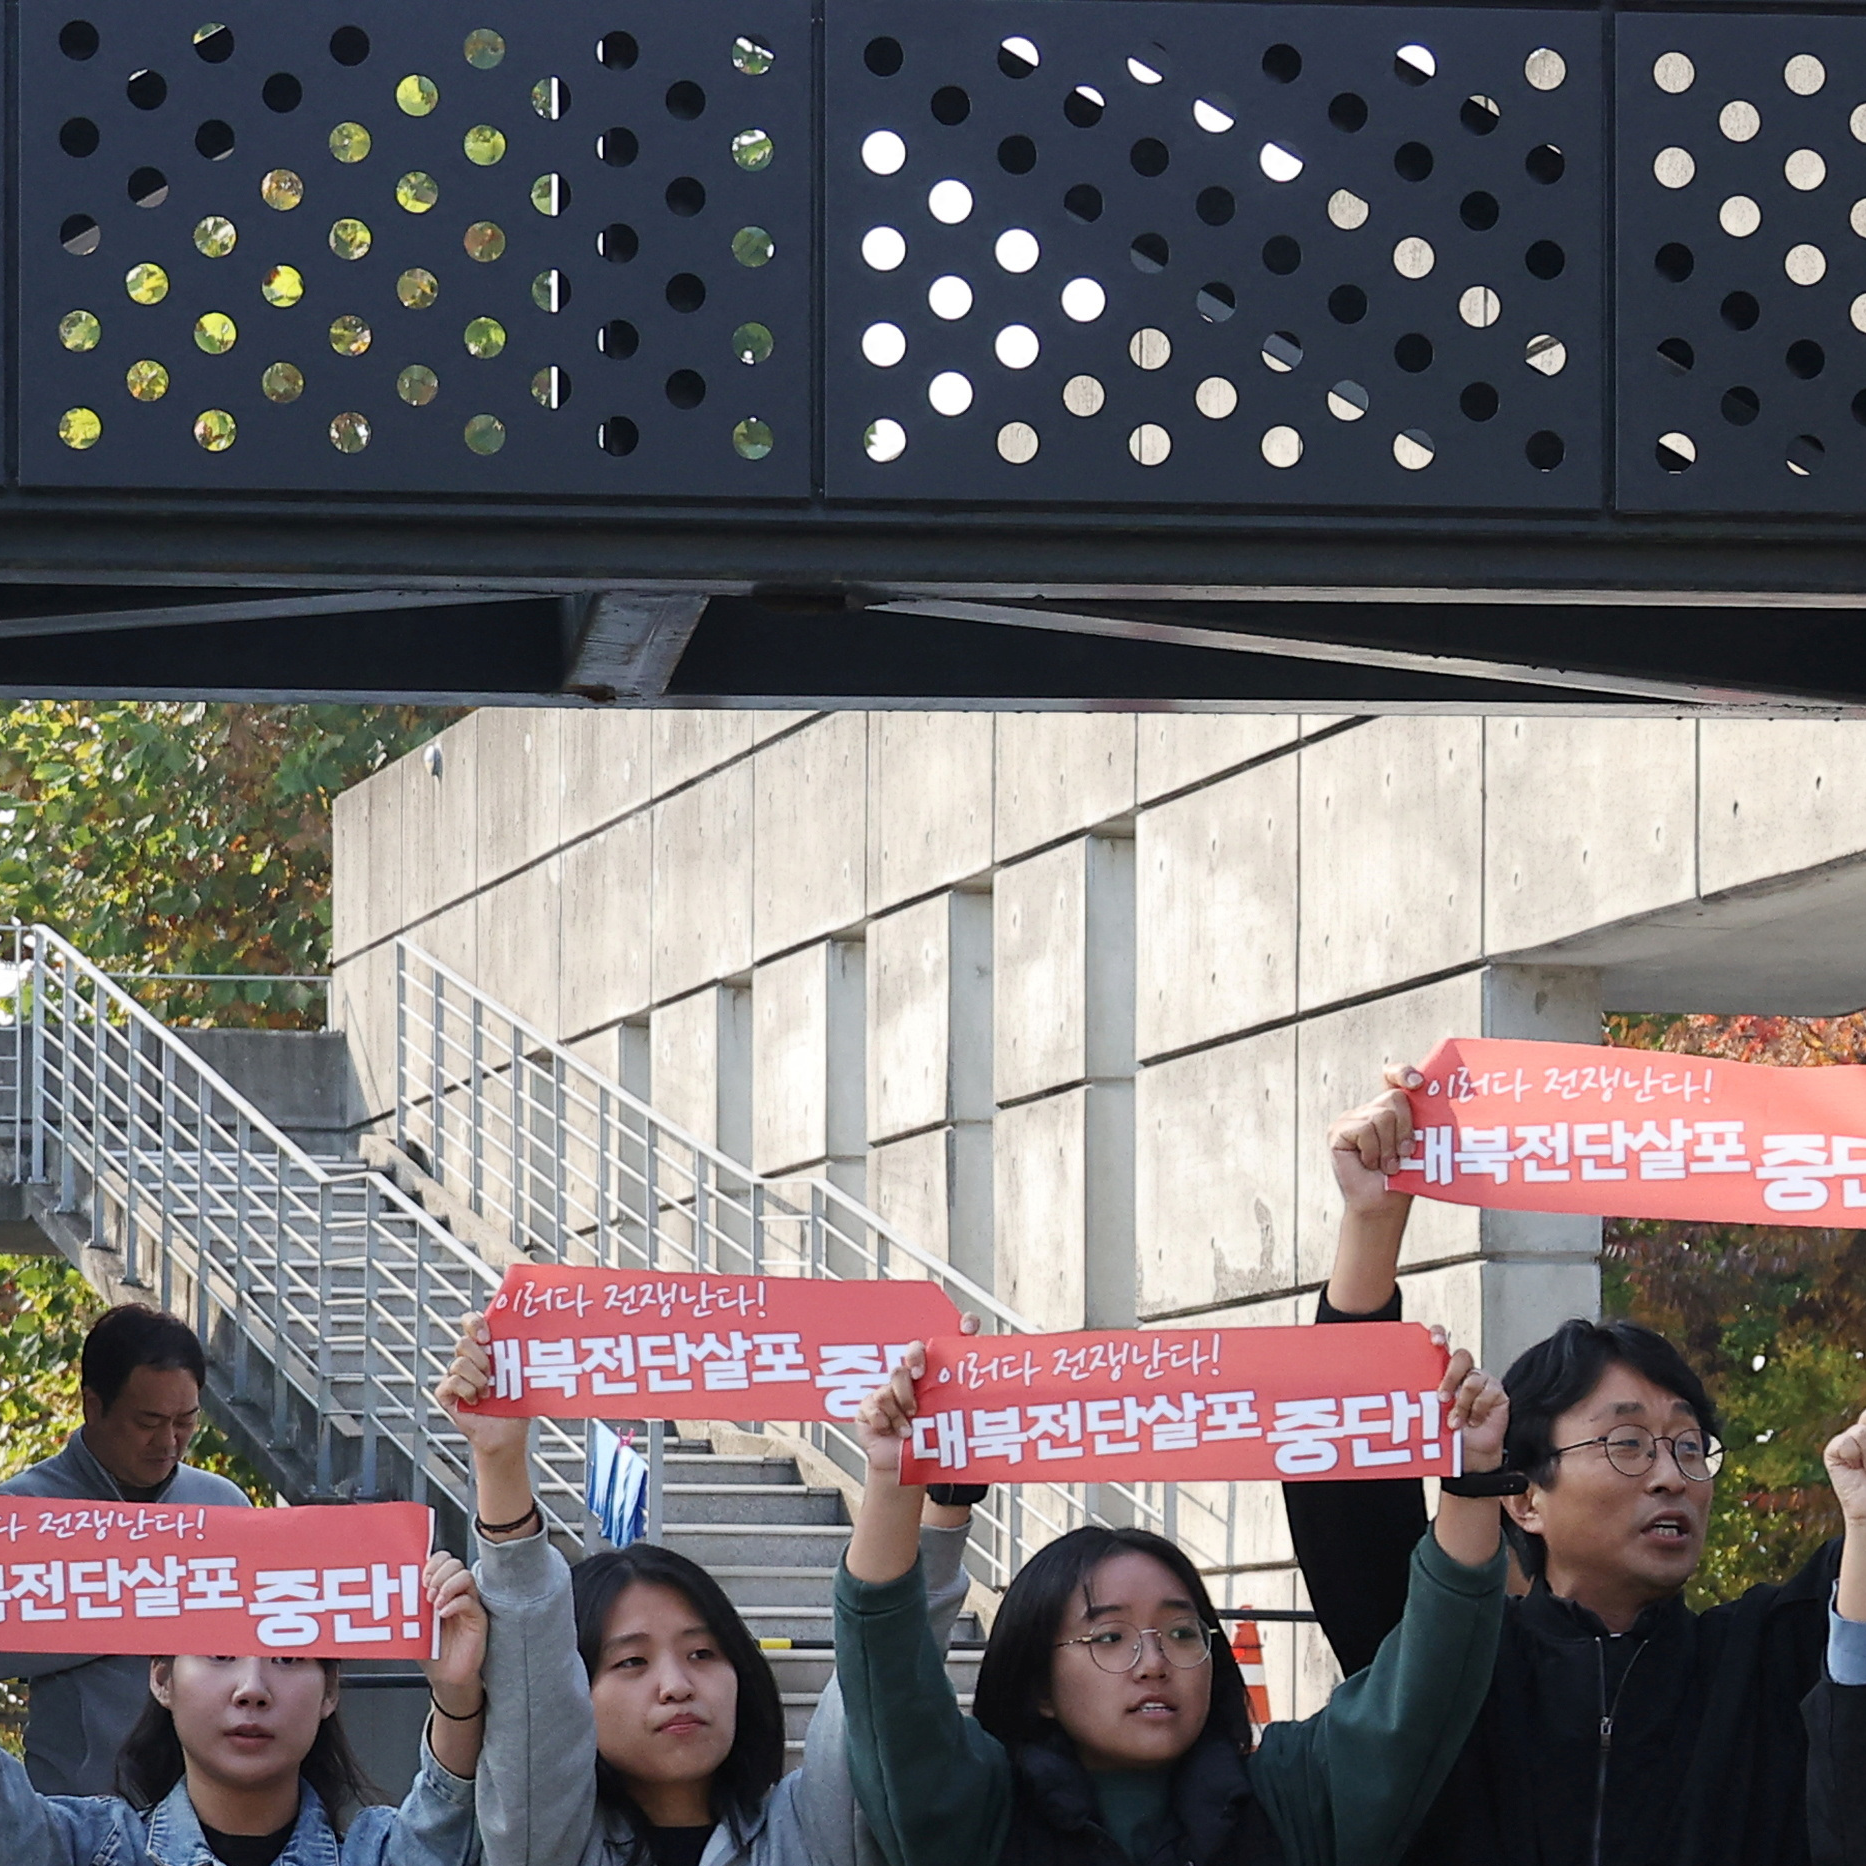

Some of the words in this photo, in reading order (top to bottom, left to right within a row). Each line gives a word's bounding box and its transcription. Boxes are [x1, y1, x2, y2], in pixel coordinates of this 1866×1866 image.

[1427, 1066, 1533, 1103] 이러다
[1543, 1066, 1714, 1104] 전쟁난다!
[1399, 1118, 1752, 1186] 대북전단살포
[495, 1280, 593, 1318] 이러다
[603, 1279, 768, 1319] 전쟁난다!
[485, 1330, 810, 1400] 대북전단살포
[937, 1351, 1042, 1391] 이러다
[1052, 1333, 1223, 1382] 전쟁난다!
[911, 1390, 1262, 1471] 대북전단살포
[1266, 1389, 1442, 1477] 중단!
[37, 1507, 208, 1542] 전쟁난다!
[248, 1563, 423, 1648] 중단!
